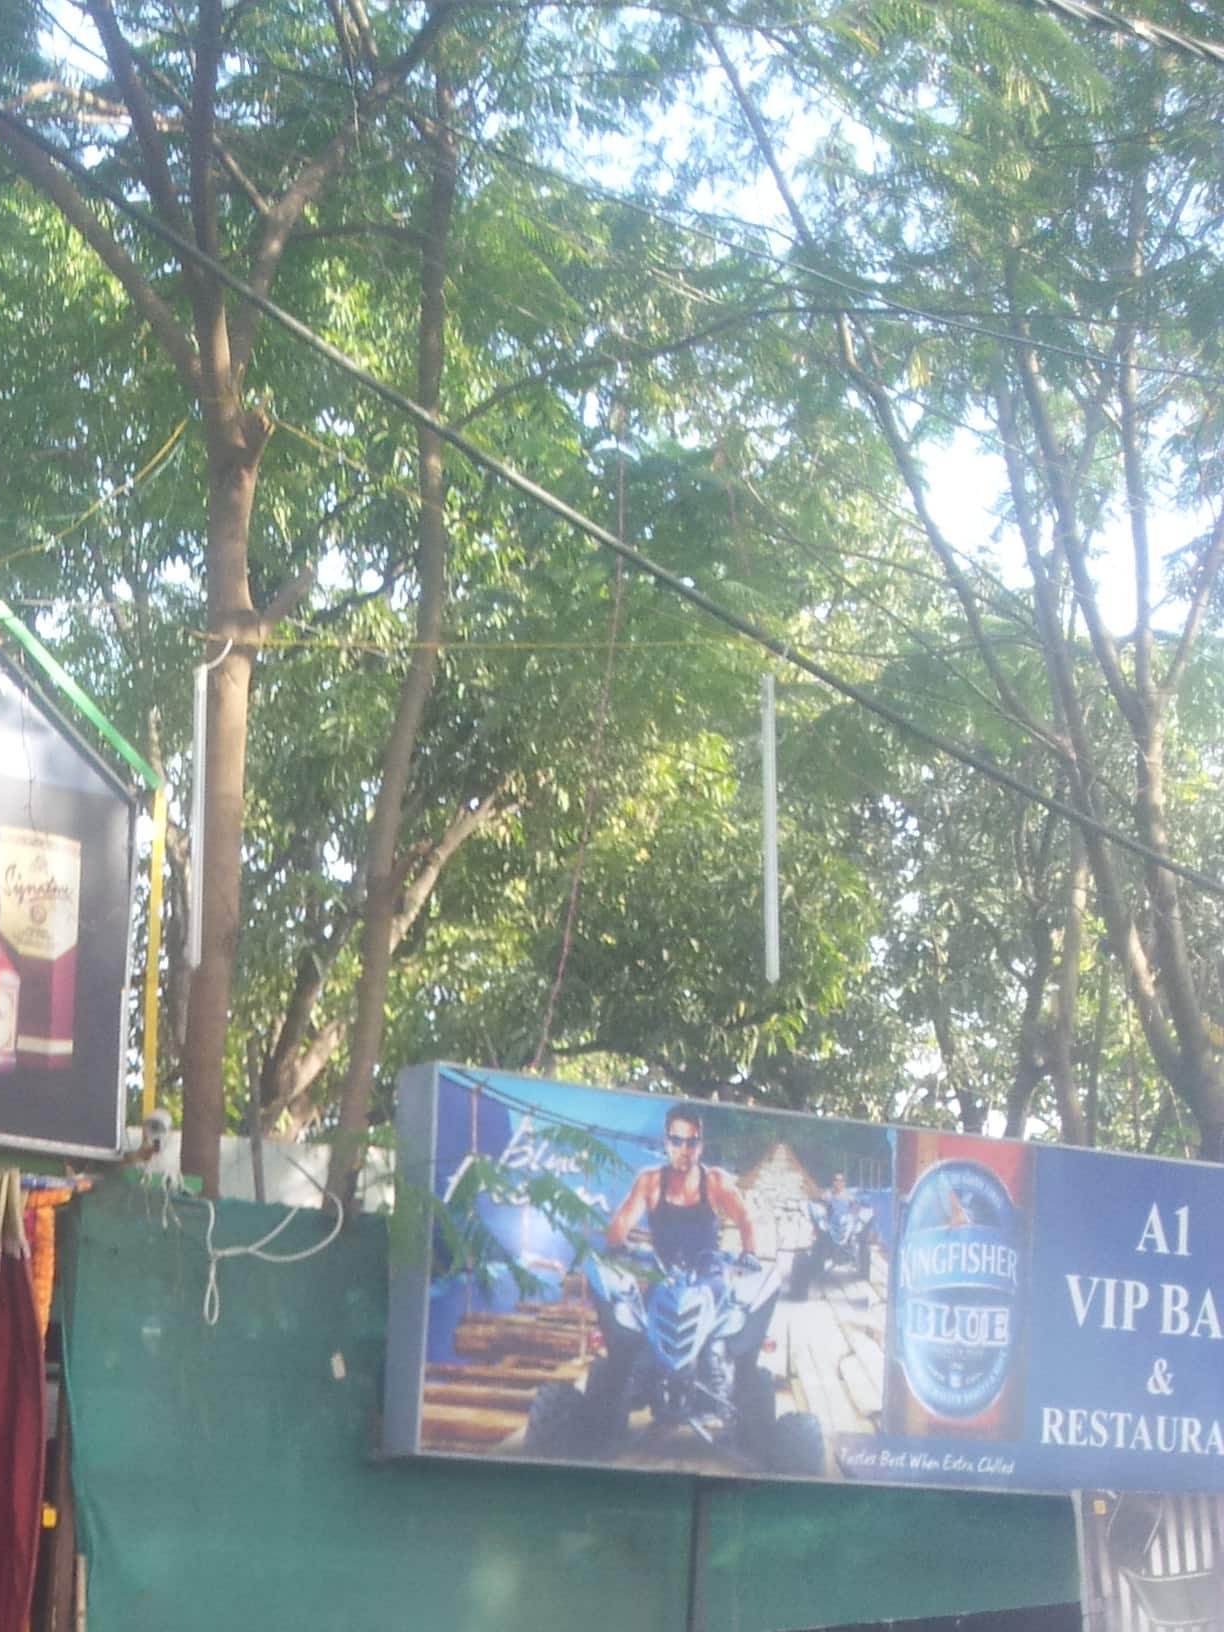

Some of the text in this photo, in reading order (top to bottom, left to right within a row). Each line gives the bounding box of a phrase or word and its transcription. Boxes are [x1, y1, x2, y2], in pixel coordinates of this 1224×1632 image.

[1134, 1201, 1193, 1257] A1
[898, 1241, 1019, 1290] KINGFISHER
[905, 1299, 1010, 1347] BLUE
[1065, 1274, 1224, 1339] VIP BA
[1146, 1357, 1175, 1396] &
[1040, 1406, 1224, 1456] RESTAURA
